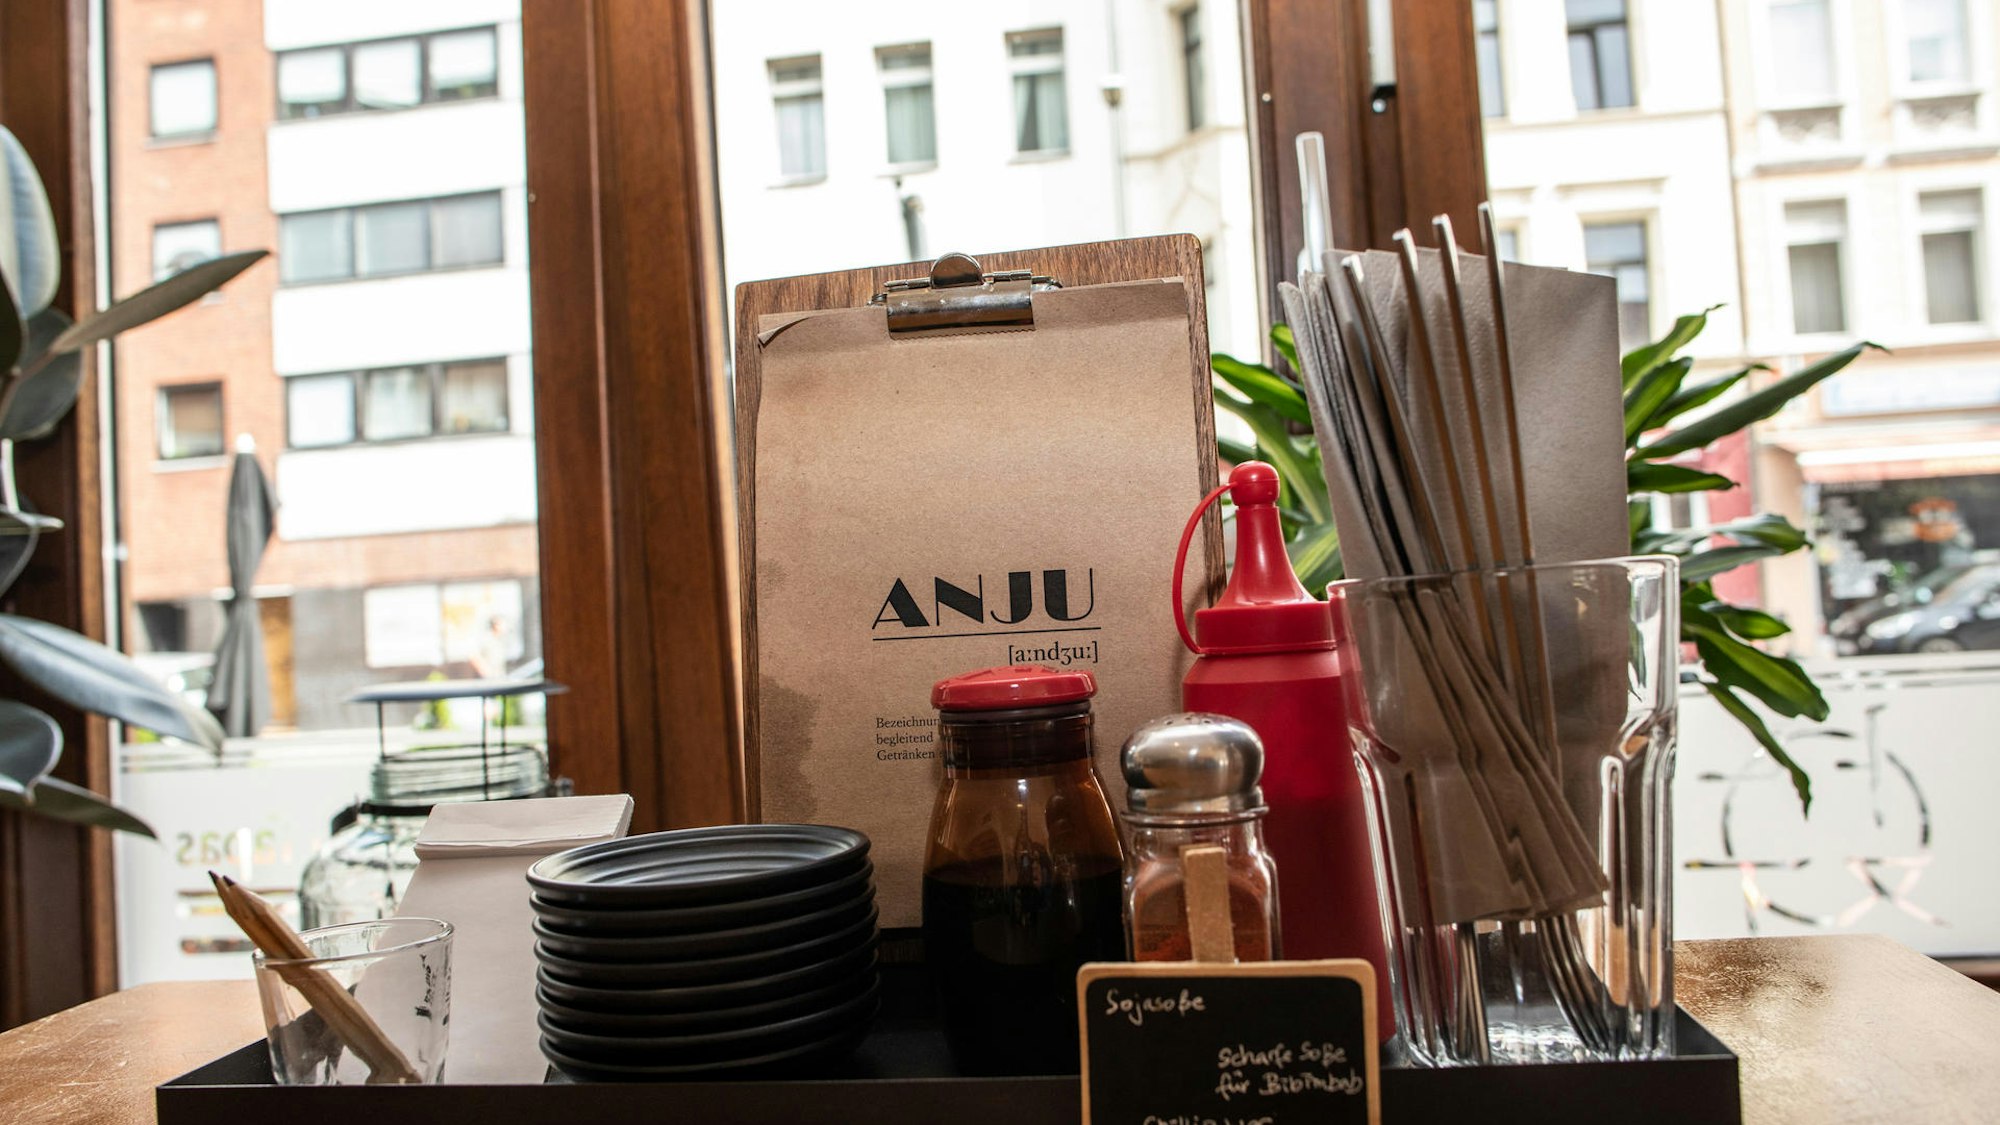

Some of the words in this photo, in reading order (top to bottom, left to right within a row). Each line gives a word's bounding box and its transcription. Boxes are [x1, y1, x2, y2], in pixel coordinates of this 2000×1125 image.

[872, 568, 1094, 630] ANJU
[876, 716, 940, 729] Bezeichnun
[876, 732, 934, 747] begleitend
[877, 748, 936, 761] Getränken
[1215, 1069, 1250, 1101] für
